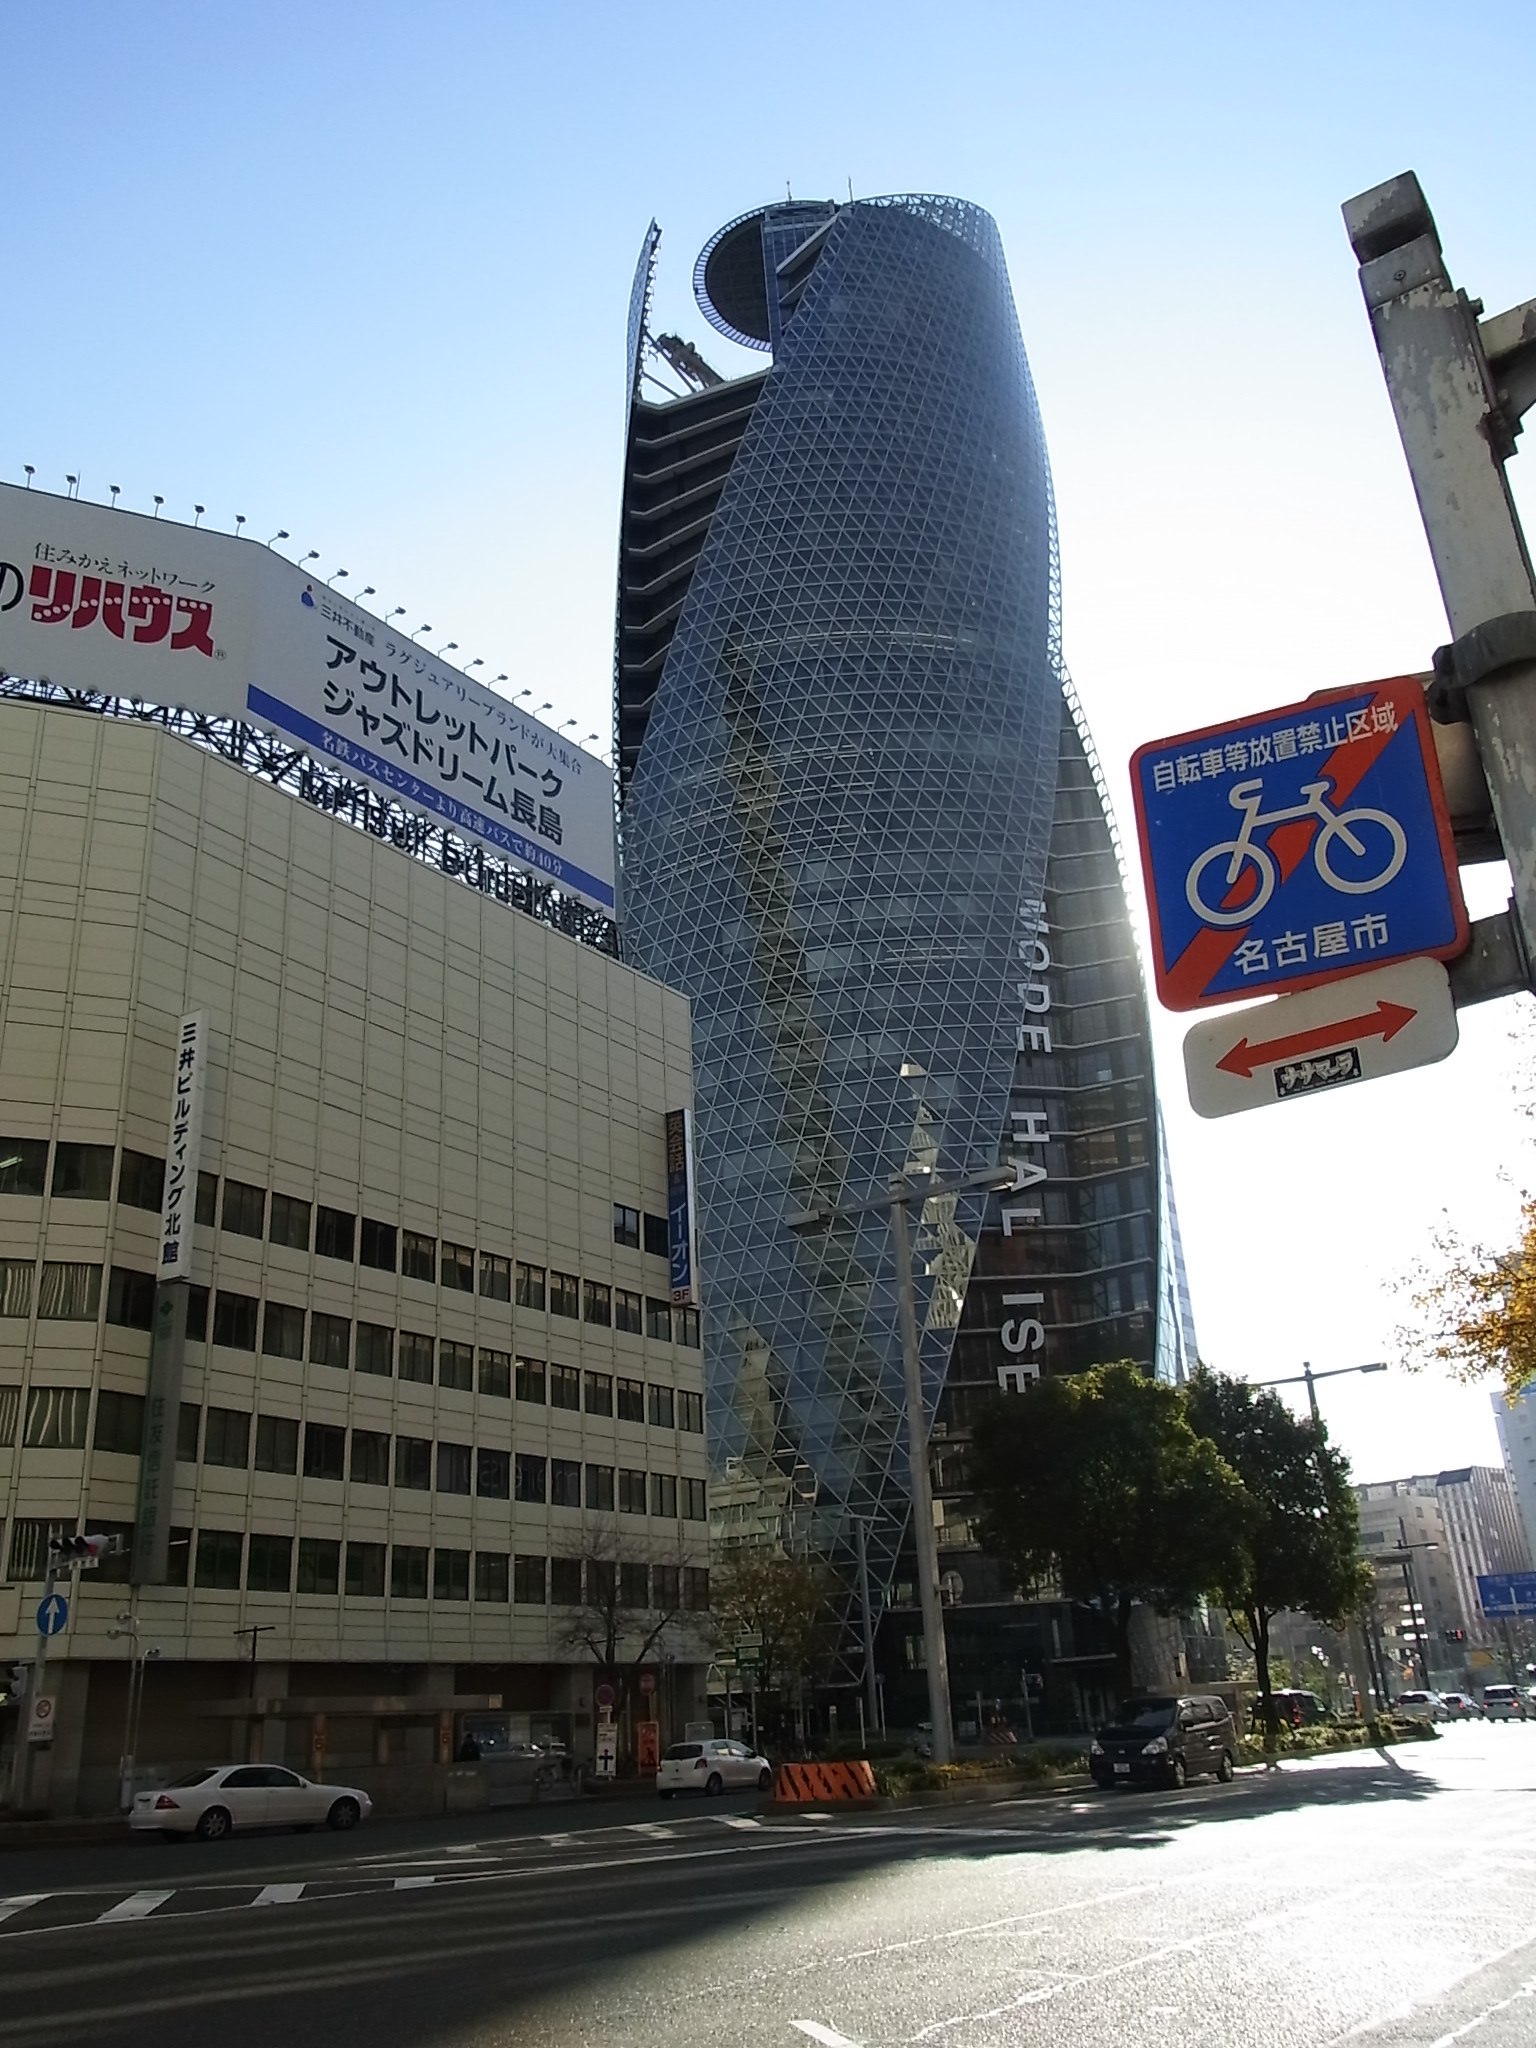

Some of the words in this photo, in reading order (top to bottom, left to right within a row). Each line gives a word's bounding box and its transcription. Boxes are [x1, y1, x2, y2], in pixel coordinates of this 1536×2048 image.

[34, 542, 216, 594] 住みかえネットワーク
[321, 603, 375, 648] 三井不動産
[323, 680, 562, 846] ジャズドリーム長島
[326, 634, 563, 798] アウトレットパーク
[1152, 702, 1399, 793] 自転車等放置禁止区域
[320, 731, 564, 876] 名鉄バスセンターより高速バスで約40分
[1015, 899, 1052, 1053] MODE
[1233, 912, 1388, 976] 名古屋市
[161, 1022, 197, 1265] 三井ビルディング北館
[1002, 1110, 1049, 1237] HAL
[671, 1202, 688, 1282] イーオン
[673, 1288, 689, 1301] 3F
